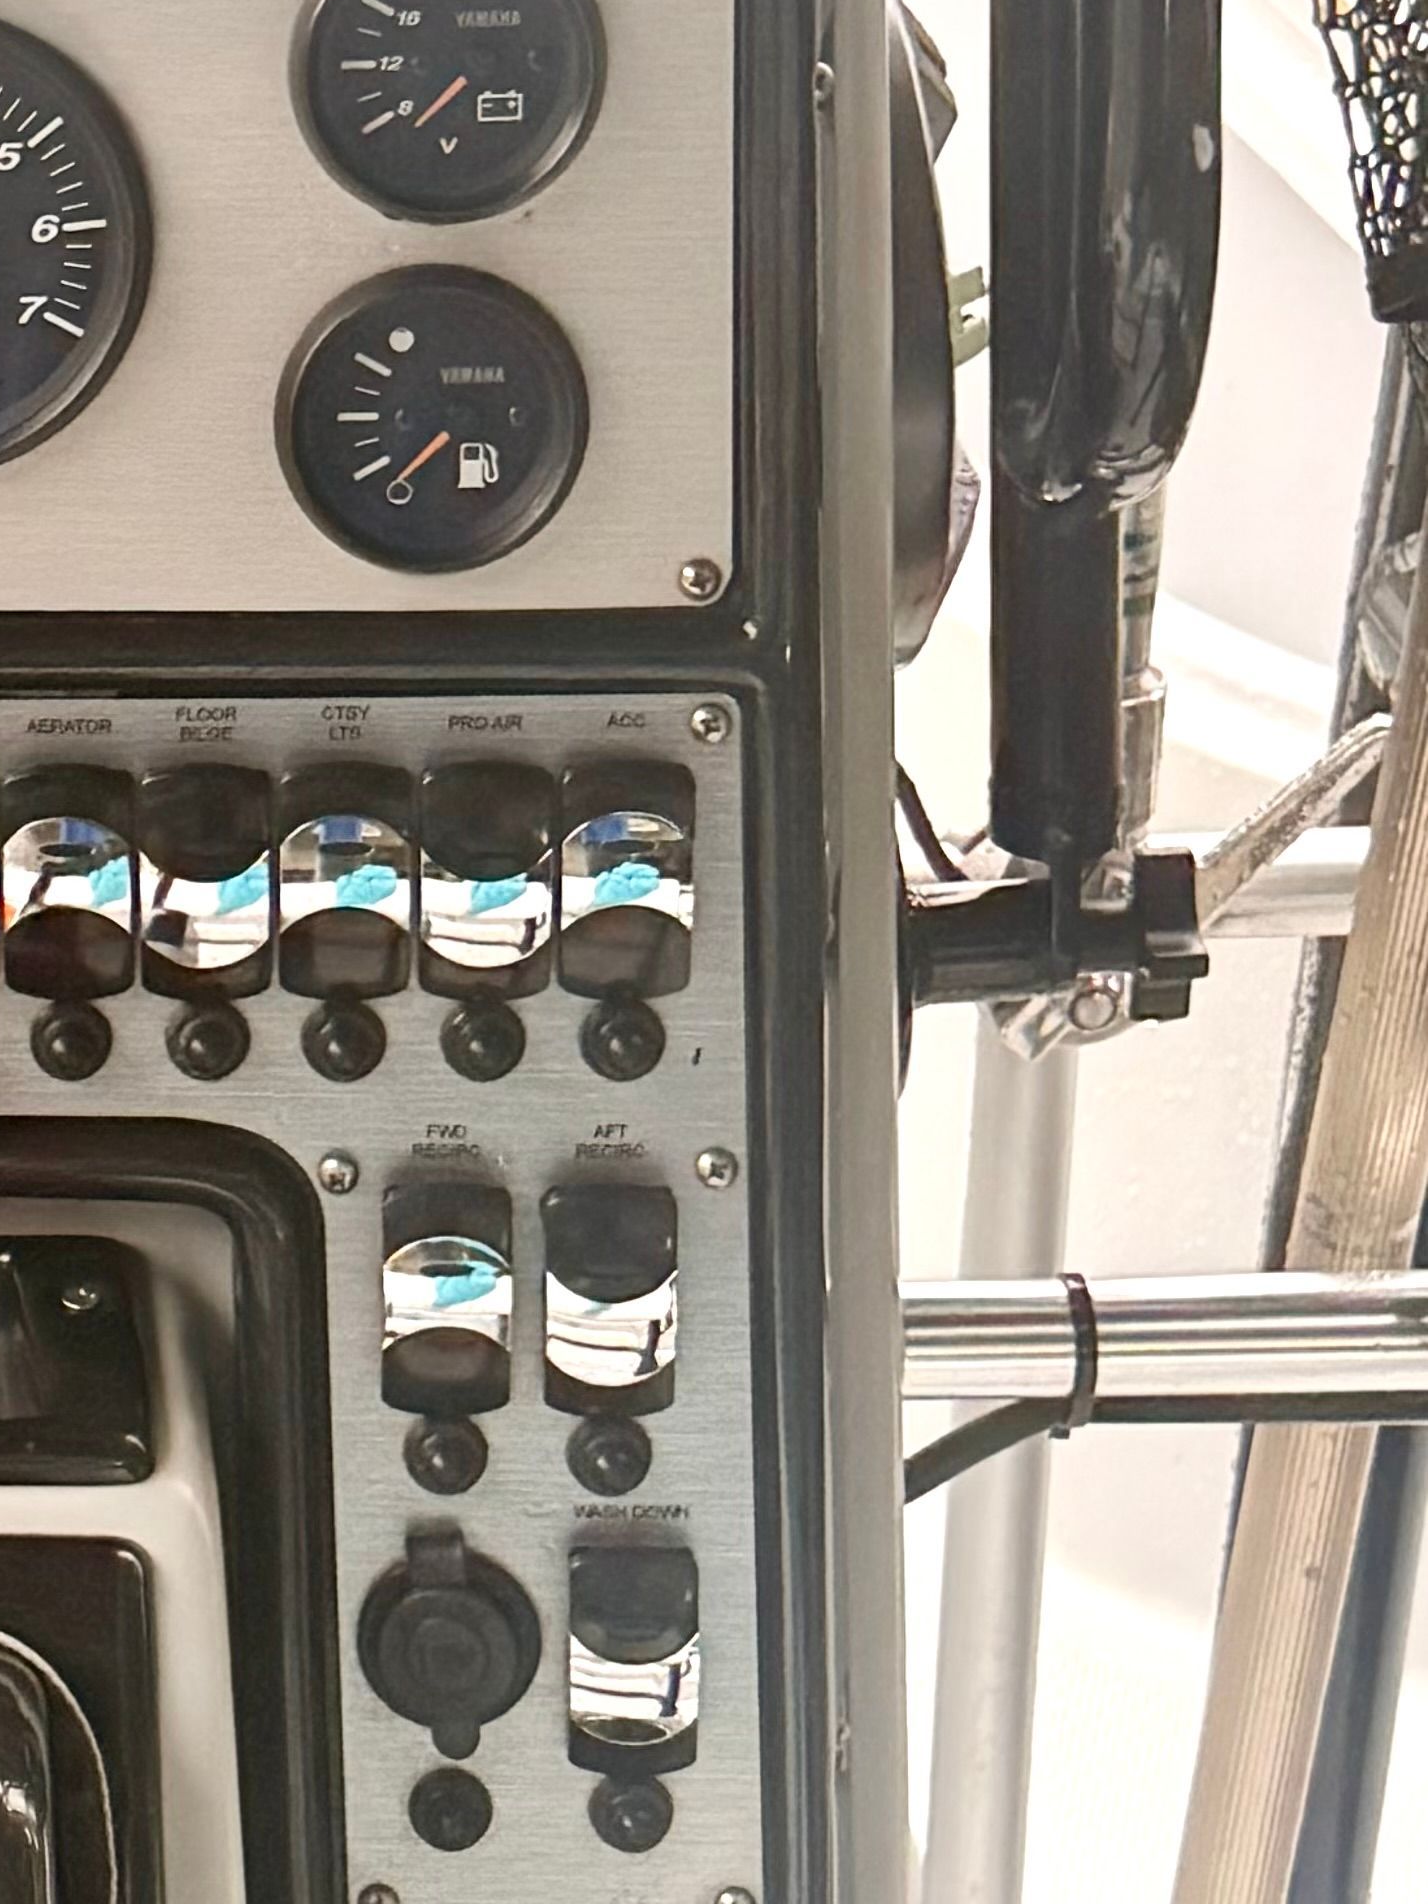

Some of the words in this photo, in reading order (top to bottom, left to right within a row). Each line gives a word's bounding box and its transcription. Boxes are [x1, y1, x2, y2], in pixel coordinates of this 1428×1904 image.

[396, 10, 421, 26] 16
[455, 10, 521, 27] YAMAHA
[379, 56, 404, 71] 12
[397, 100, 414, 116] 8
[31, 214, 61, 243] 6
[17, 295, 49, 325] 7
[440, 367, 506, 384] YAMAHA
[175, 706, 238, 722] FLOOR
[607, 711, 647, 728] ACC
[26, 718, 113, 734] AERATOR
[426, 1124, 468, 1139] FWD
[594, 1123, 628, 1139] AFT
[573, 1503, 628, 1519] WASH
[632, 1503, 690, 1519] DOWN
